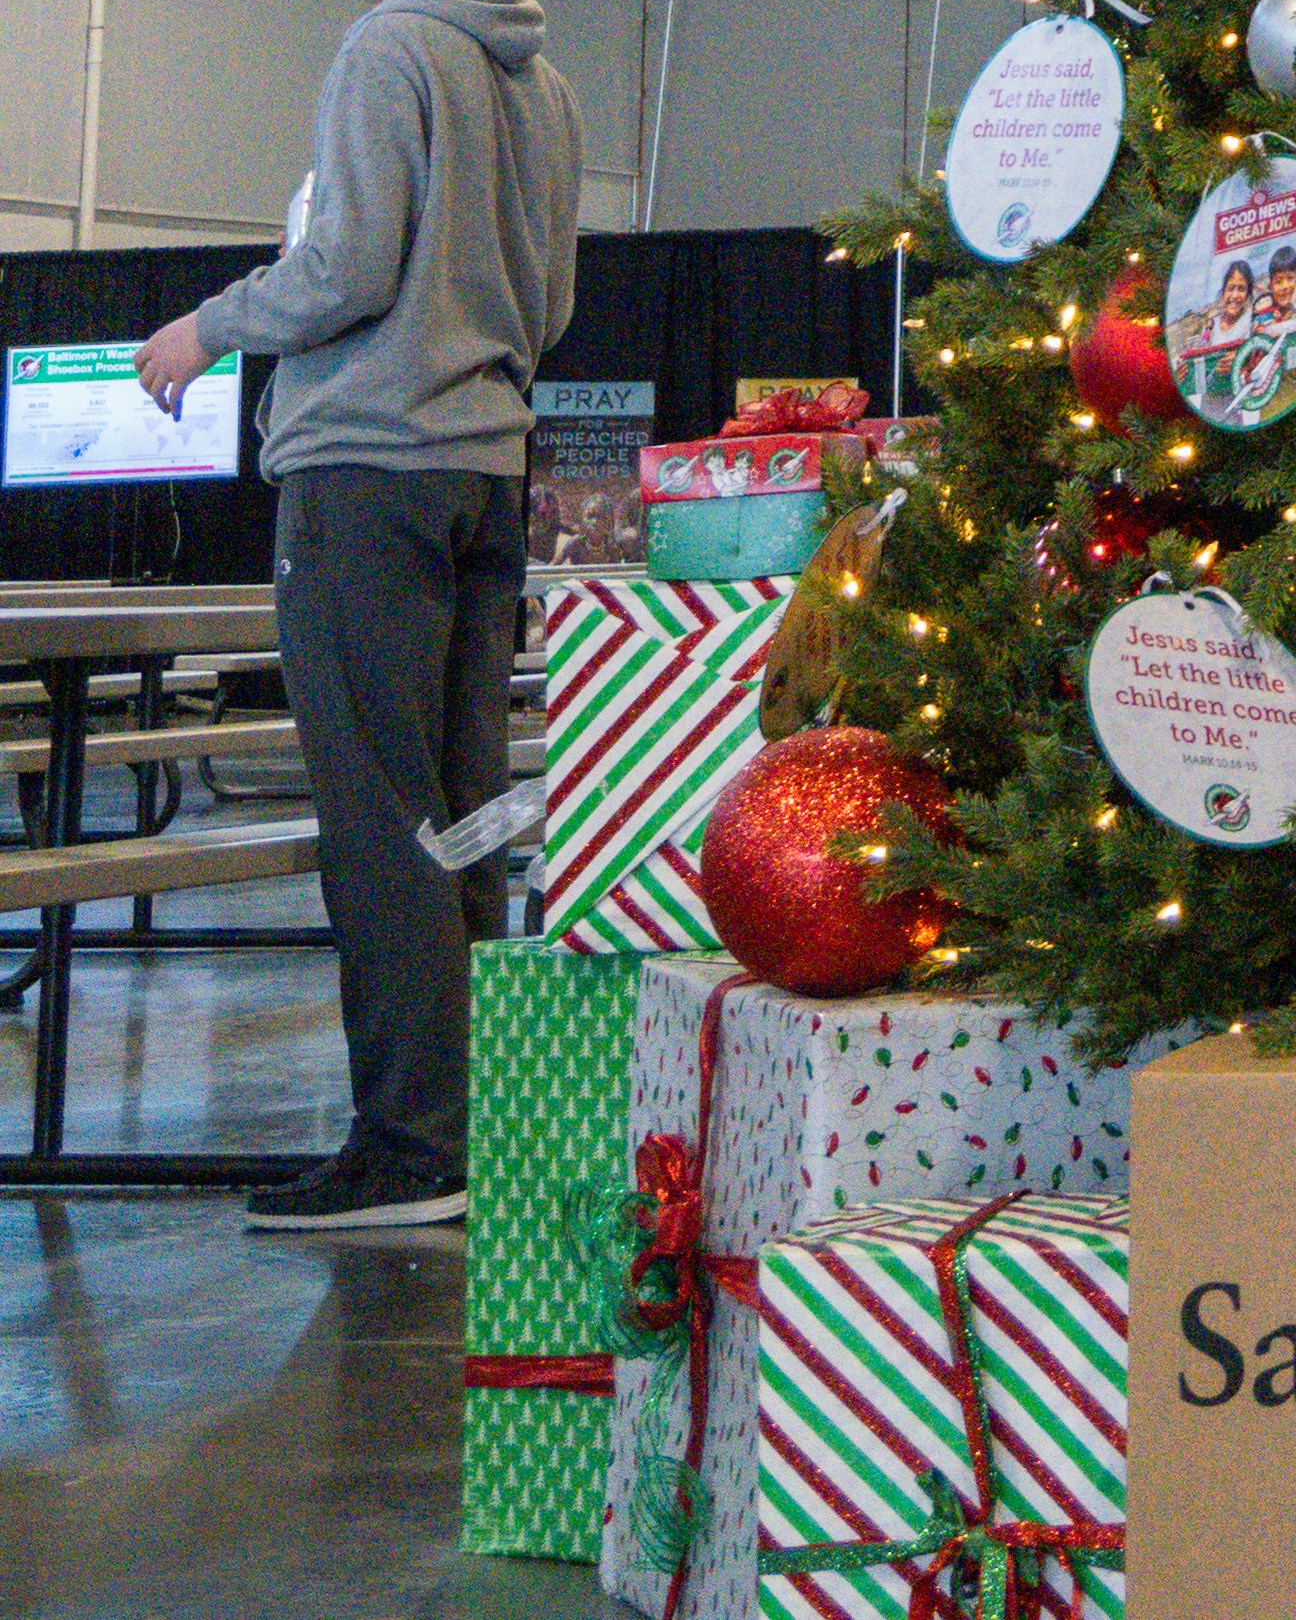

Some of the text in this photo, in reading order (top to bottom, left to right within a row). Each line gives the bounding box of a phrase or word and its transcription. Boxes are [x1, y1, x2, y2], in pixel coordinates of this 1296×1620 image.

[1000, 58, 1094, 80] Jesus said,
[989, 88, 1101, 108] "Let the little
[973, 119, 1102, 139] children come
[999, 150, 1017, 168] to
[1219, 210, 1257, 232] GOOD
[1225, 214, 1292, 245] GREAT JOY.
[47, 351, 98, 362] Baltimore
[47, 364, 93, 375] Shoebox
[555, 388, 632, 409] PRAY
[537, 431, 649, 446] UNREACHED
[556, 448, 629, 462] PEOPLE
[552, 465, 631, 479] GROUPS
[1126, 626, 1264, 663] Jesus said,
[1121, 654, 1286, 693] "Let the little
[1116, 686, 1226, 716] children
[1170, 723, 1258, 750] to Me."
